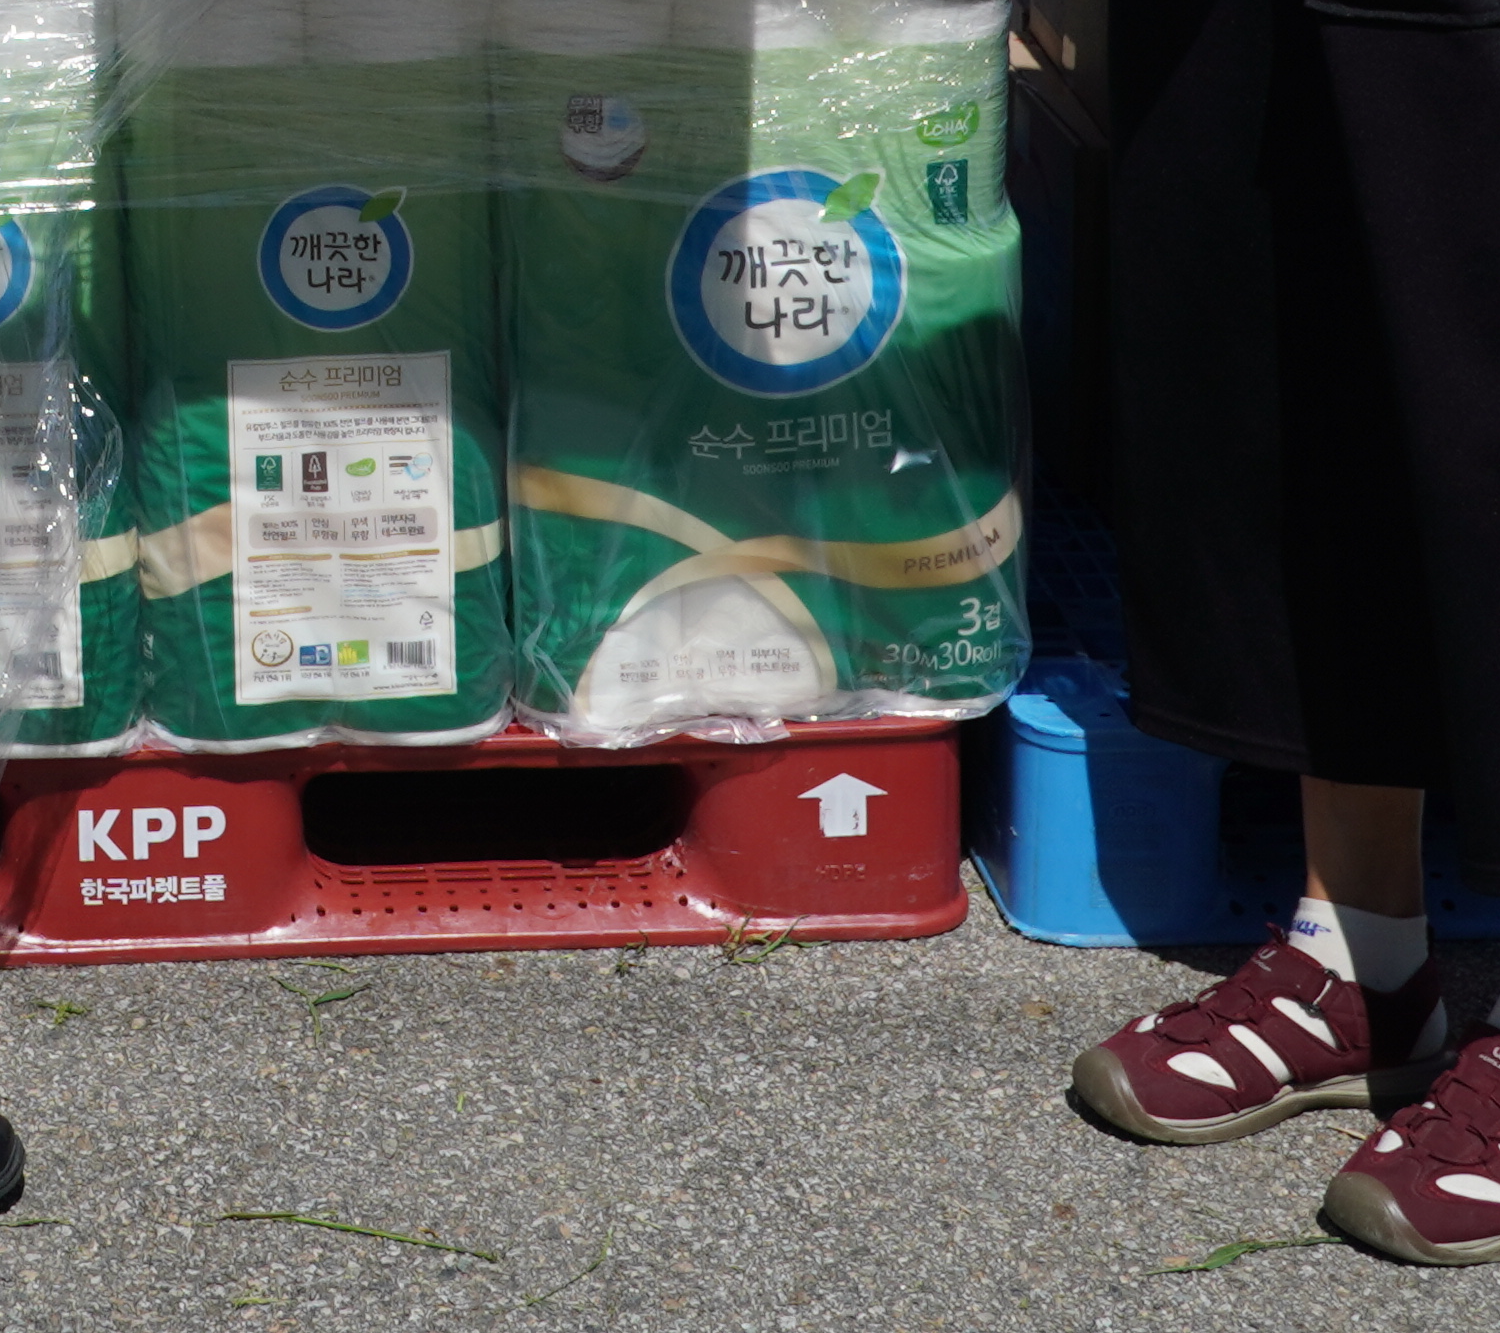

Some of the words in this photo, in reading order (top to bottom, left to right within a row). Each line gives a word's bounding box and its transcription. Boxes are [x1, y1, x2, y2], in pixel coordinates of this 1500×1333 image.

[922, 105, 973, 137] LOHAS
[291, 231, 382, 263] 깨끗한
[718, 238, 858, 289] 깨끗한
[306, 265, 366, 294] 나라
[744, 295, 836, 340] 나라
[279, 369, 318, 392] 순수
[323, 365, 403, 388] 프리미엄
[688, 426, 757, 460] 순수
[764, 410, 894, 457] 프리미엄
[791, 456, 840, 473] PREMIUM
[904, 527, 1000, 574] PREMIUM
[957, 597, 1001, 636] 3겹
[78, 805, 226, 862] KPP
[80, 874, 227, 905] 한국파렛트풀
